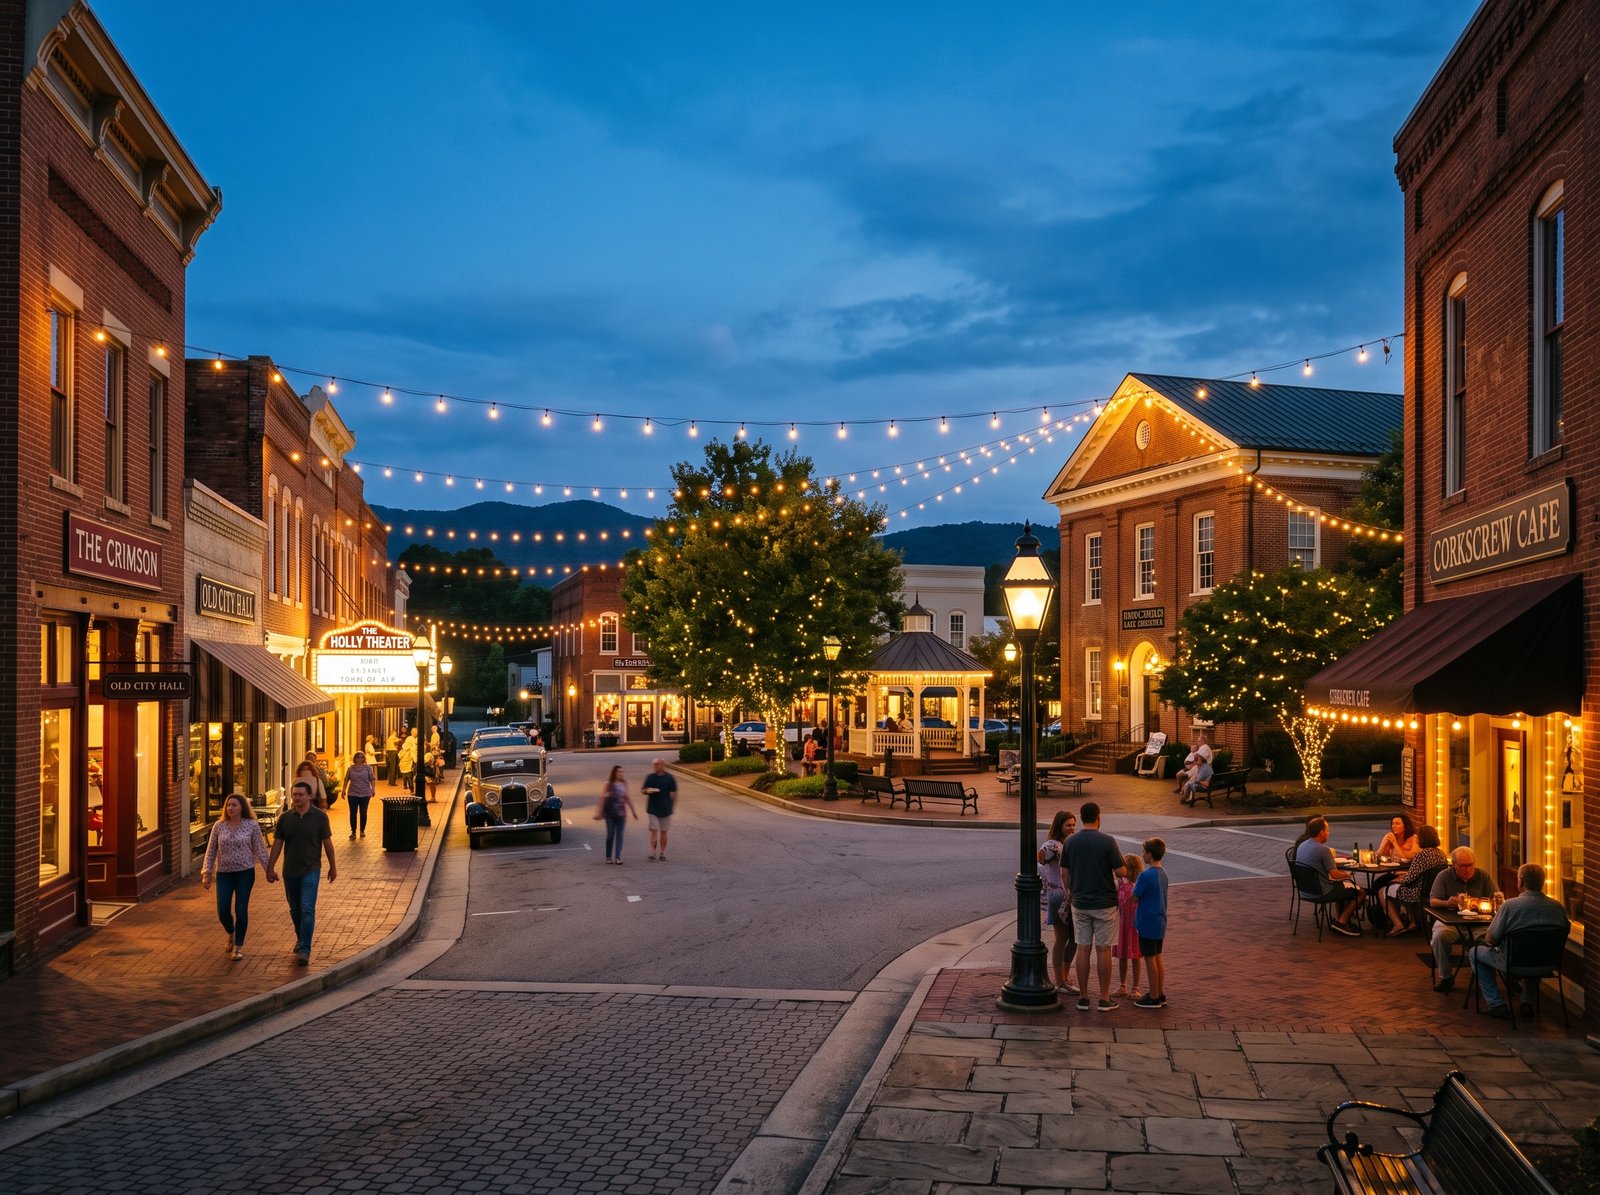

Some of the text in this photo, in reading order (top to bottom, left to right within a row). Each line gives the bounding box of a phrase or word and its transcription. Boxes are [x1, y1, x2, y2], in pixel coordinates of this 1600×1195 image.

[1433, 498, 1560, 572] CORKSCREW CAFE
[75, 527, 158, 578] THE CRIMSON
[202, 583, 254, 619] OLD CITY HALL
[361, 627, 378, 635] THE
[330, 635, 411, 649] HOLLY THEATER
[110, 681, 185, 690] OLD CITY HALL
[1356, 689, 1370, 707] CAFE
